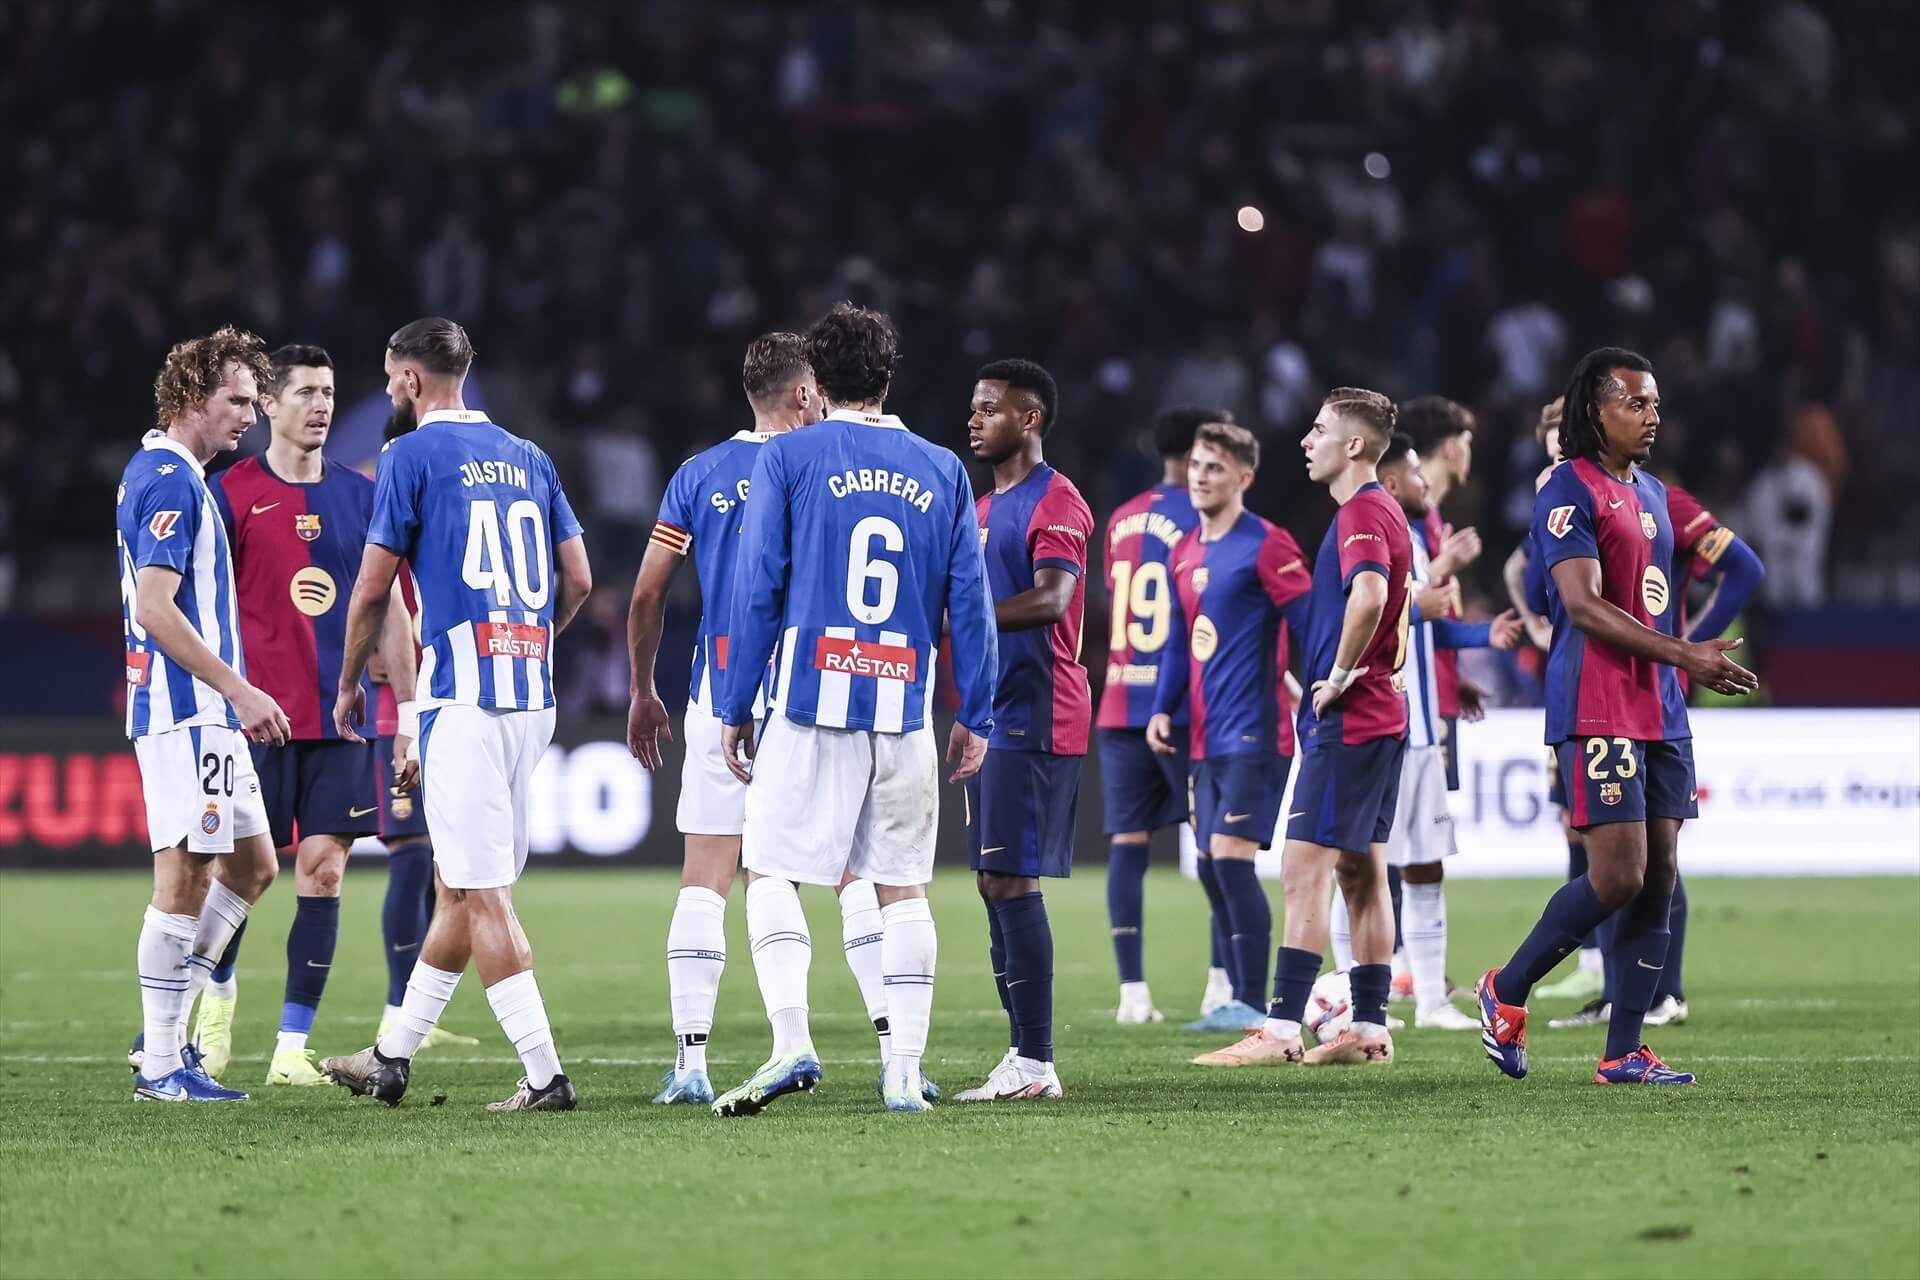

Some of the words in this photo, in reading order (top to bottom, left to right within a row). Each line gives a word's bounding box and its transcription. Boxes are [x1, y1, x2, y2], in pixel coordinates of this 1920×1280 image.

[459, 461, 527, 489] JUSTIN
[828, 468, 934, 514] CABRERA
[711, 492, 735, 514] S.
[461, 499, 549, 610] 40
[846, 516, 904, 625] 6
[1110, 560, 1171, 653] 19
[488, 638, 542, 657] RASTAR
[825, 653, 909, 678] RASTAR
[202, 752, 234, 797] 20
[1586, 737, 1637, 780] 23
